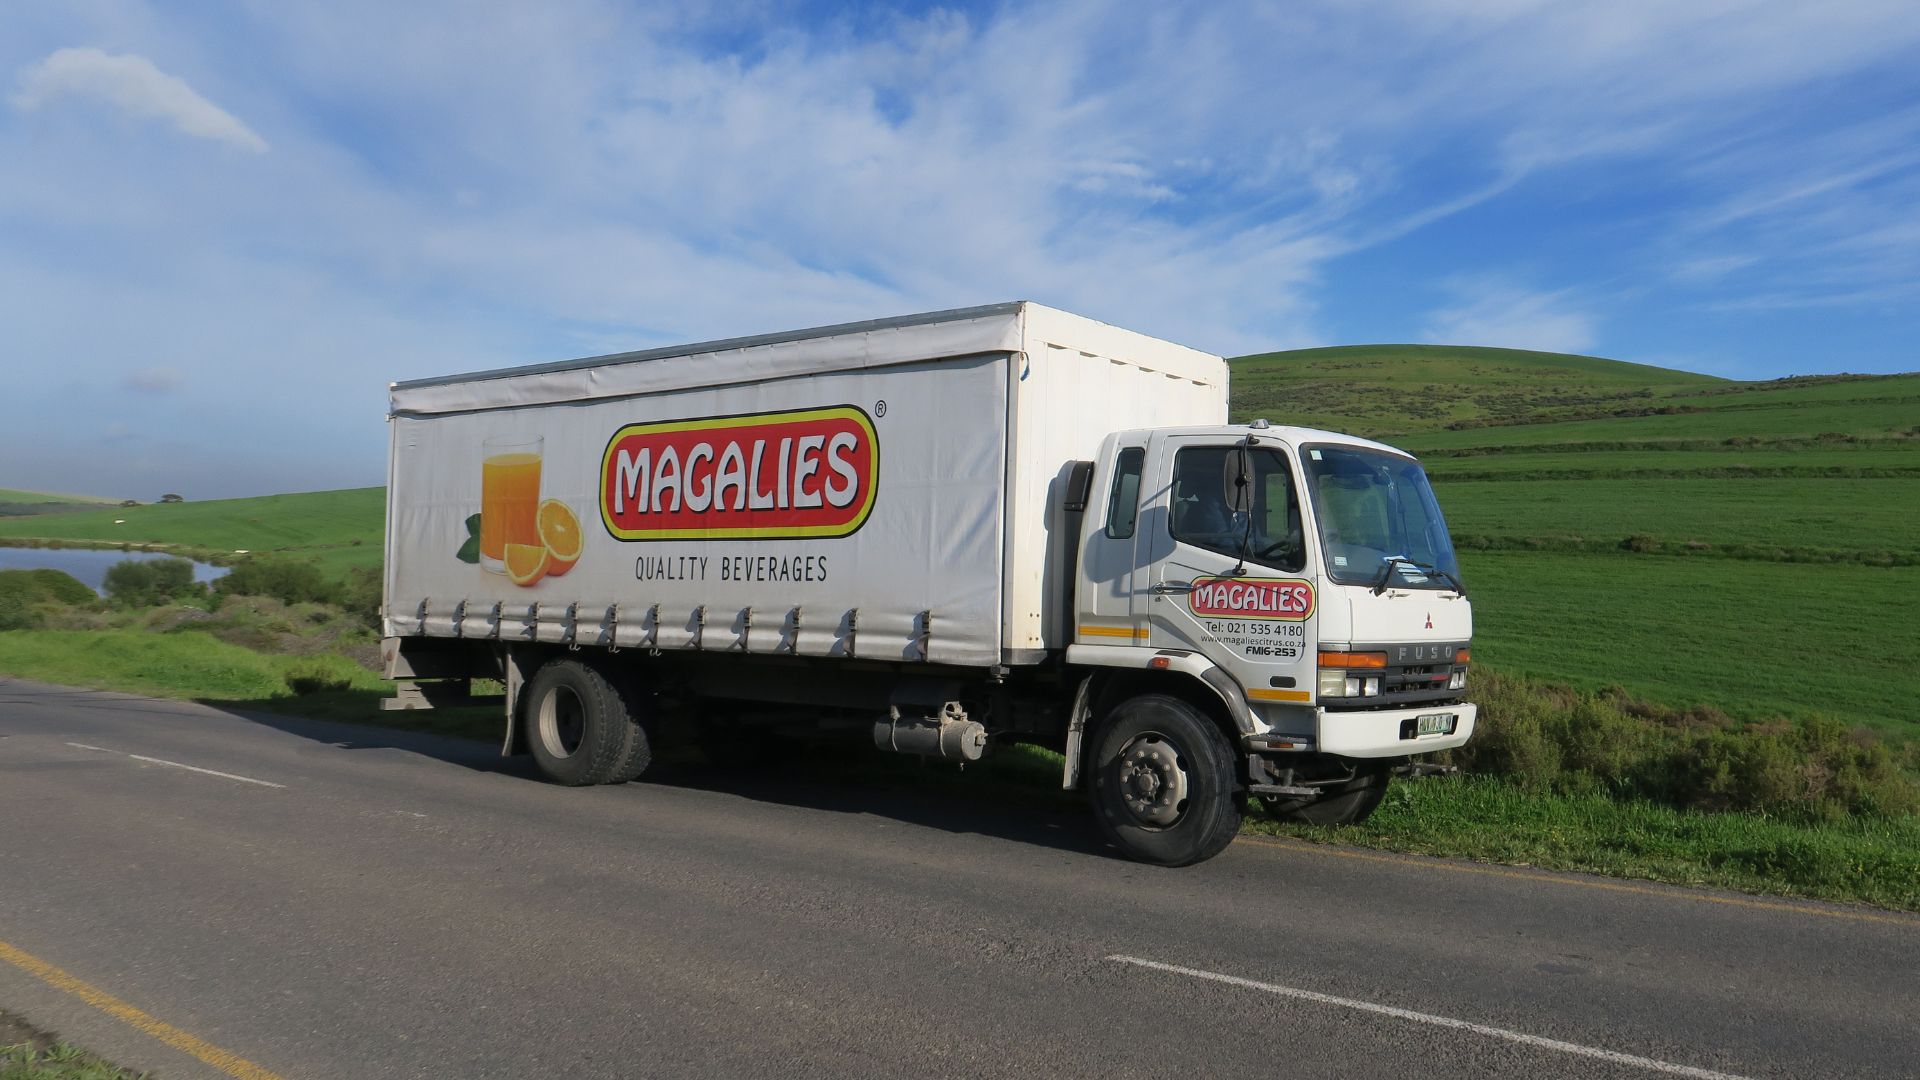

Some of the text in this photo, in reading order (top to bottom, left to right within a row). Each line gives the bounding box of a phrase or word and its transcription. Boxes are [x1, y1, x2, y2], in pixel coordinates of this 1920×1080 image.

[614, 432, 859, 515] MAGALIES
[635, 555, 828, 582] QUALITY BEVERAGES
[1195, 585, 1307, 612] MAGALIES
[1206, 621, 1303, 637] Tel: 021 535 4180
[1201, 635, 1306, 648] www.magaliescitrus.co.za
[1399, 645, 1452, 661] FUSO
